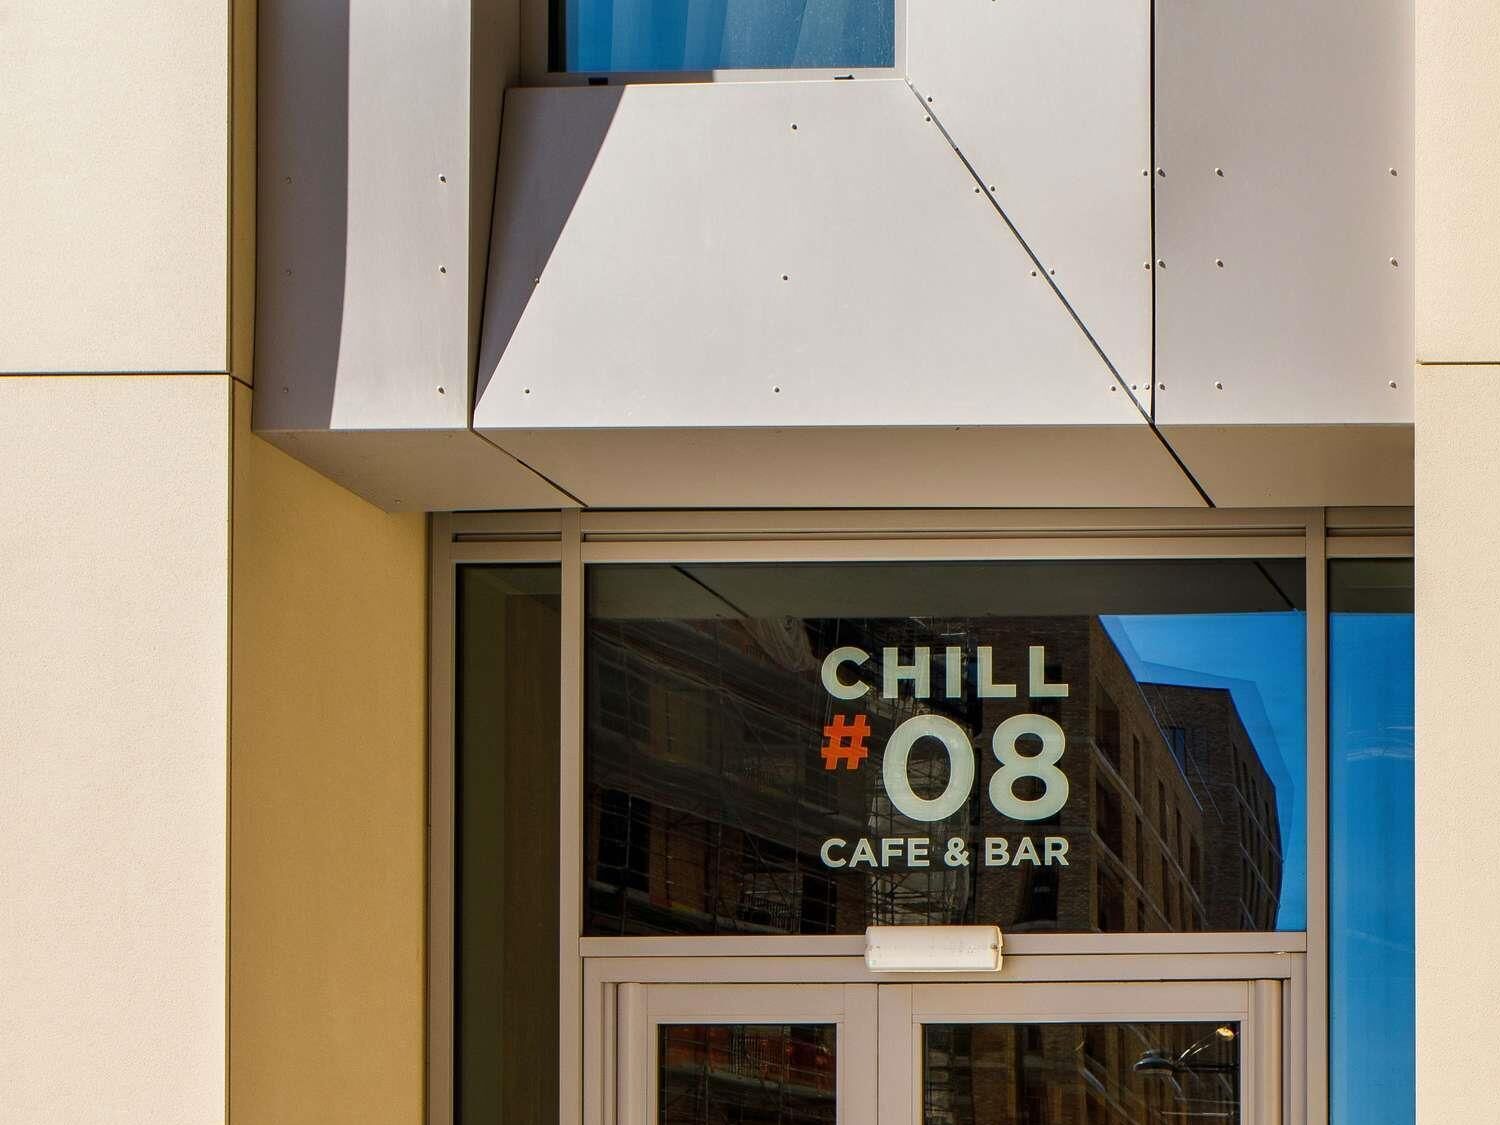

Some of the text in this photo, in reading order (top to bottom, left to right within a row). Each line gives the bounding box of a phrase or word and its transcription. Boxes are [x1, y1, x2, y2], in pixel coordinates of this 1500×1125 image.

[821, 646, 1069, 700] CHILL
[820, 837, 1070, 868] CAFE & BAR
